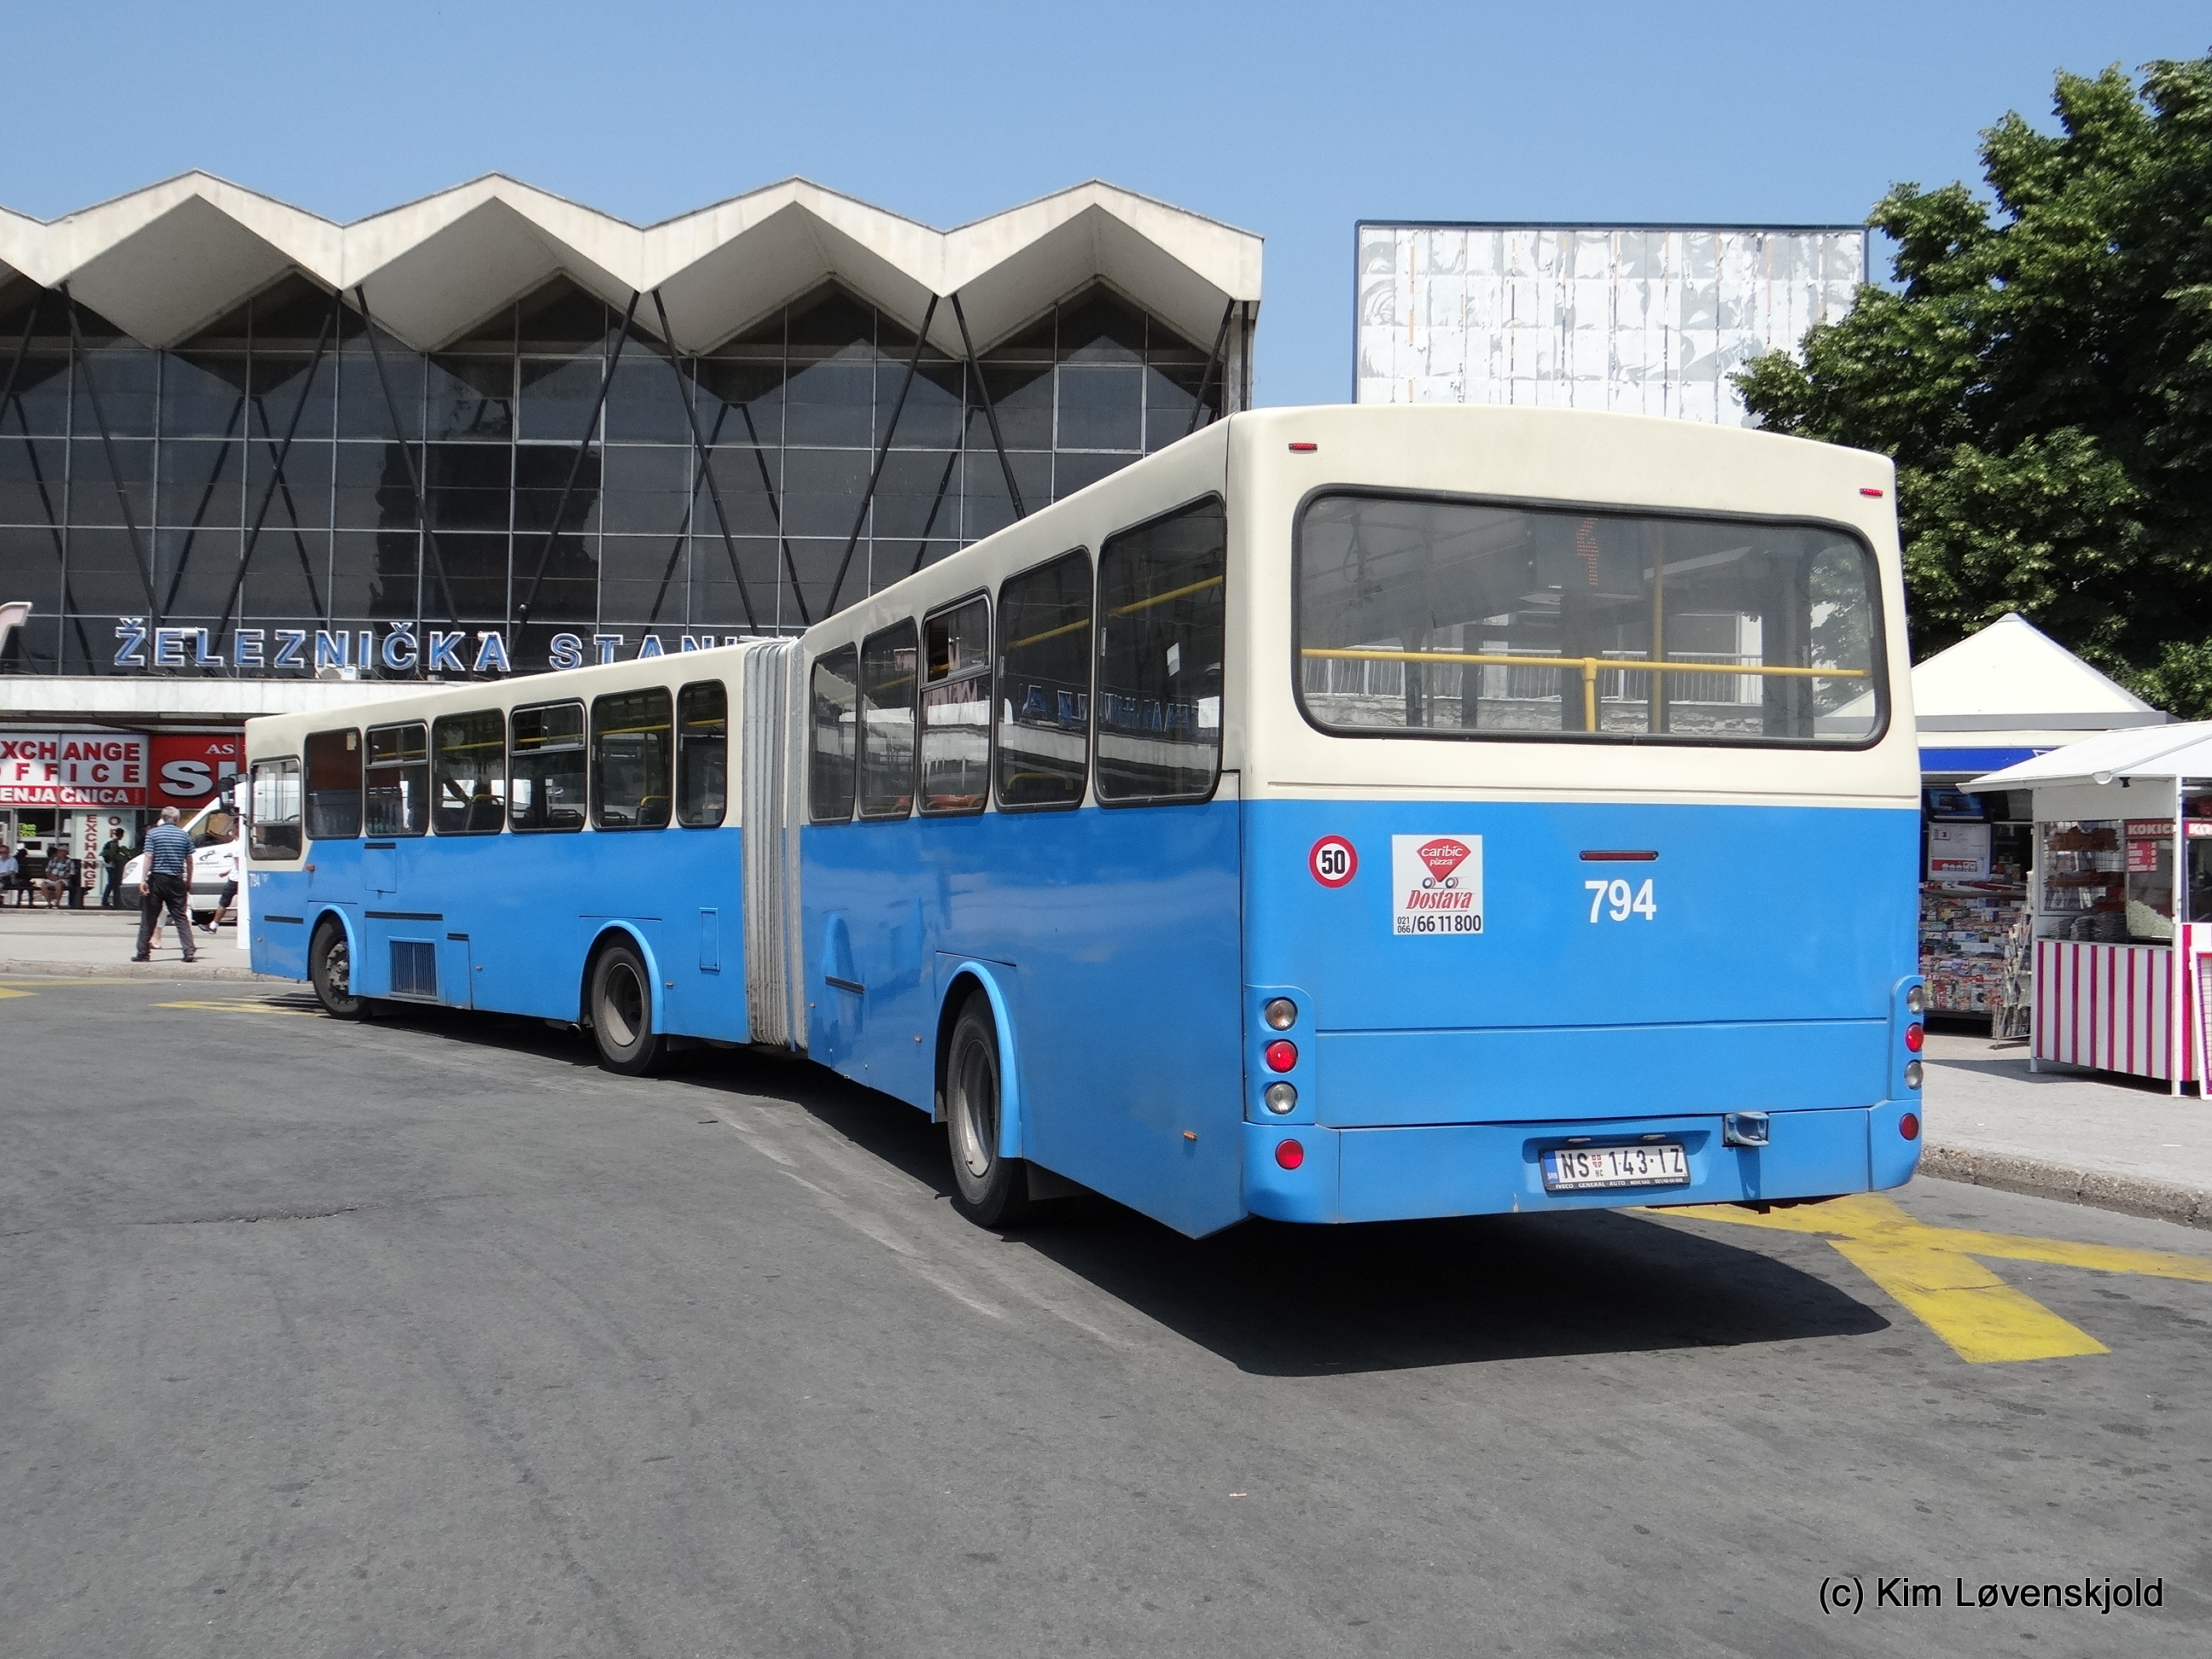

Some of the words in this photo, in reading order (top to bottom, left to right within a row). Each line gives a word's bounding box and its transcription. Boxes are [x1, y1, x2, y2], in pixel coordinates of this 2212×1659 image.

[114, 618, 510, 672] ŽELEZNIČKA
[549, 633, 737, 671] STA
[205, 743, 235, 754] AS
[0, 763, 139, 783] FFICE
[2128, 824, 2174, 835] KOKIC
[84, 814, 97, 888] EXCHANGE
[1421, 845, 1464, 857] caribic
[1321, 850, 1345, 874] 50
[1429, 858, 1452, 866] pizza
[1406, 889, 1473, 910] Dostava
[1585, 879, 1656, 923] 794
[1397, 925, 1411, 934] 066
[1561, 1152, 1590, 1179] NS
